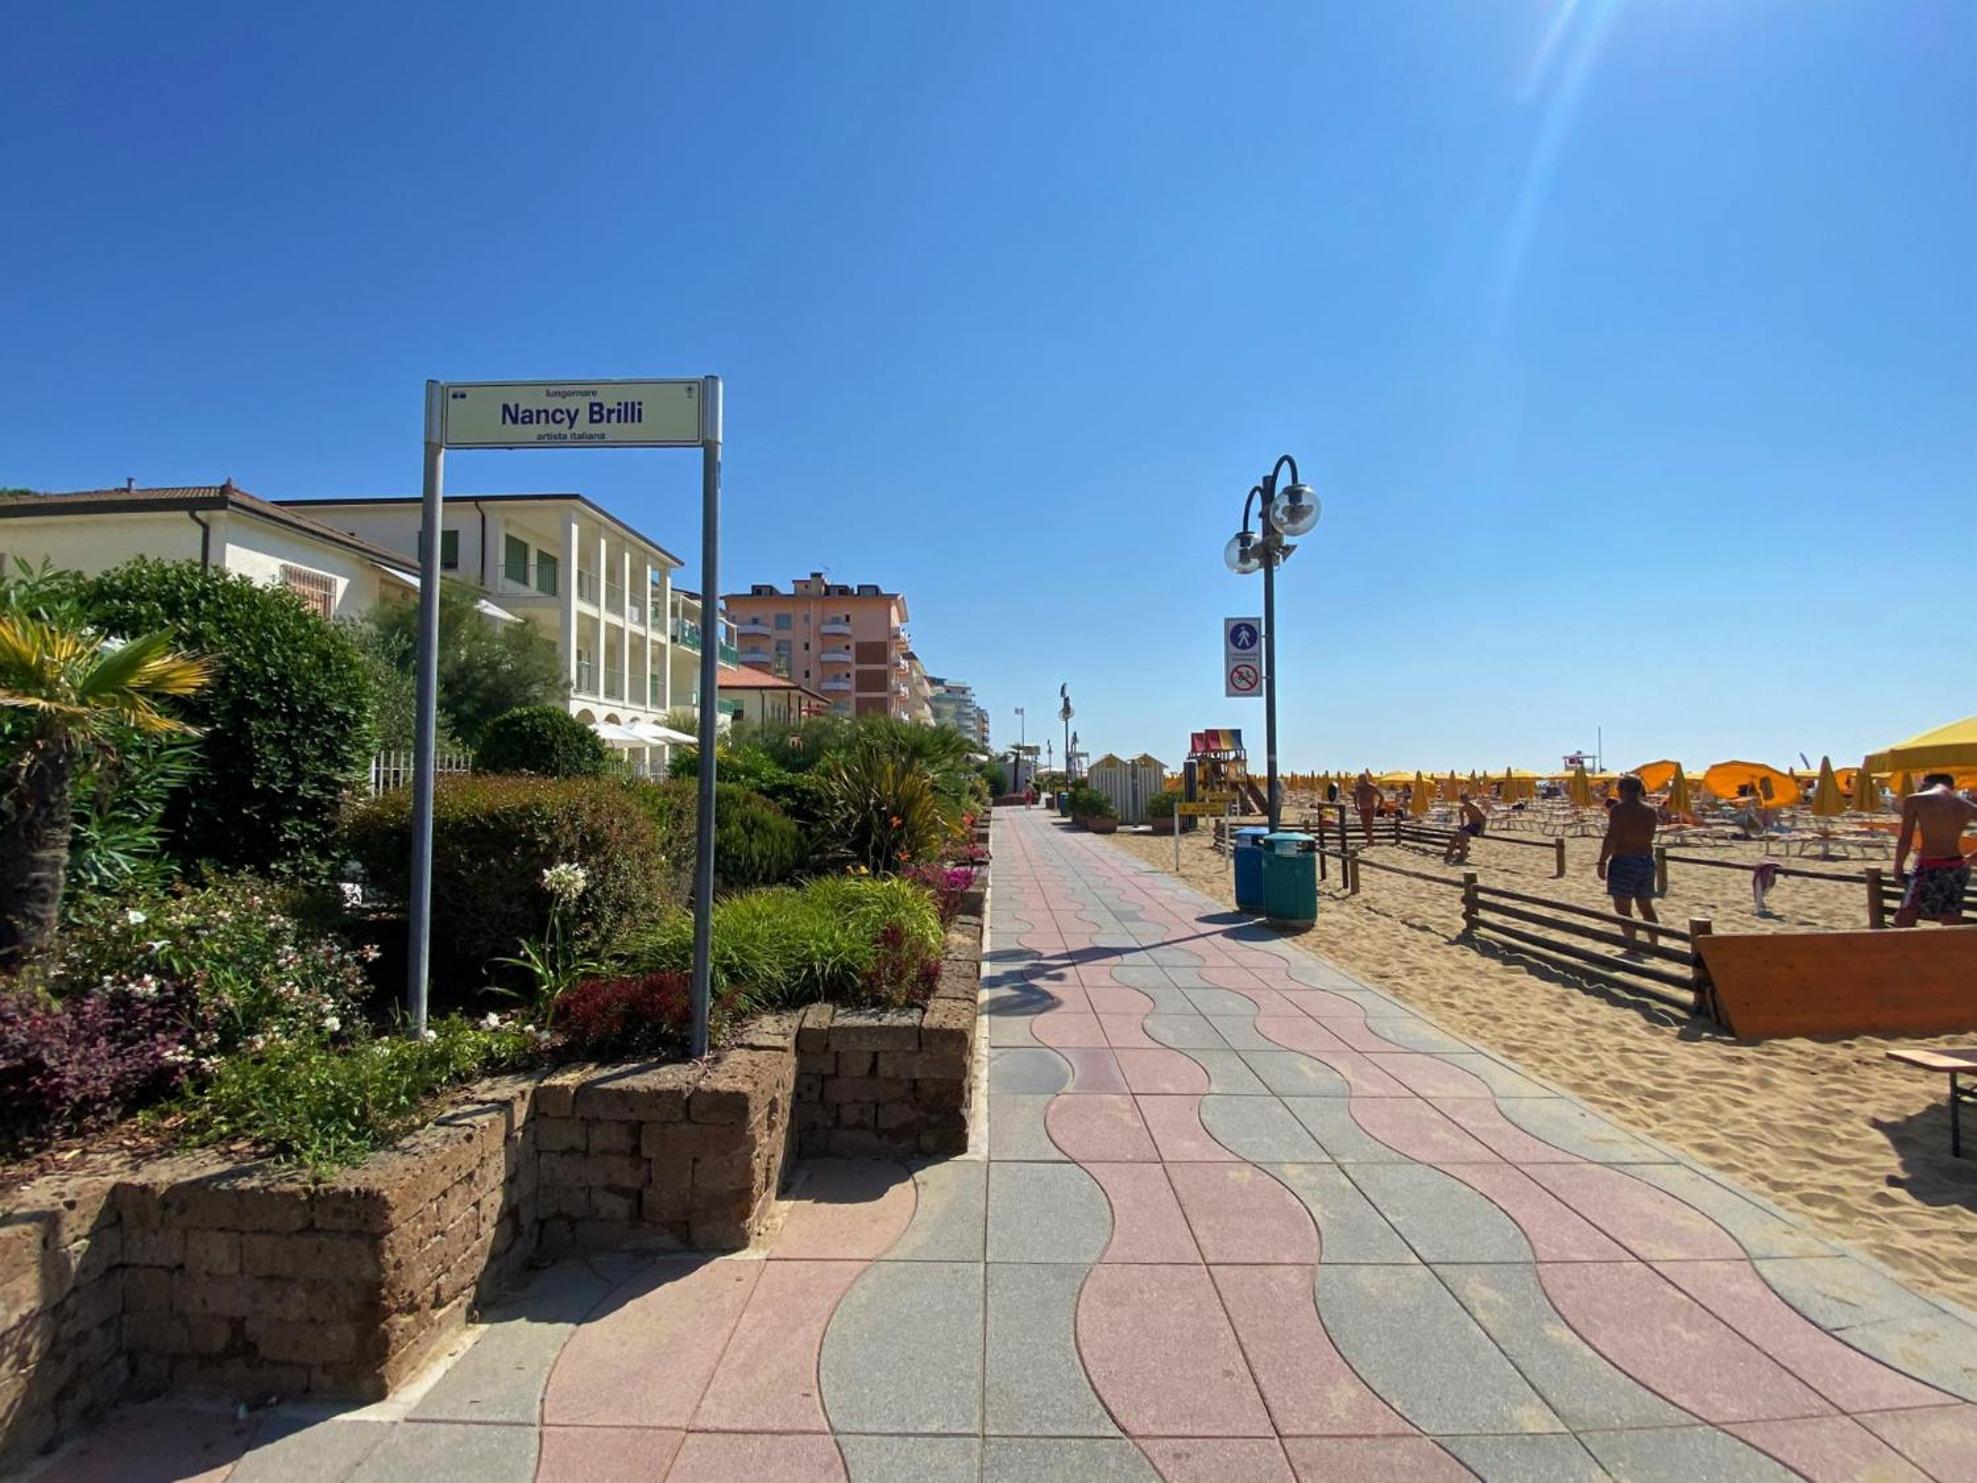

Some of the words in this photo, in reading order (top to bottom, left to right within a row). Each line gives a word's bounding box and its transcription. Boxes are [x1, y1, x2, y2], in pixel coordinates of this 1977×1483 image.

[545, 389, 598, 399] lungomare
[501, 402, 580, 430] Nancy
[588, 401, 643, 425] Brilli
[536, 432, 568, 441] artista
[569, 431, 606, 440] italiana
